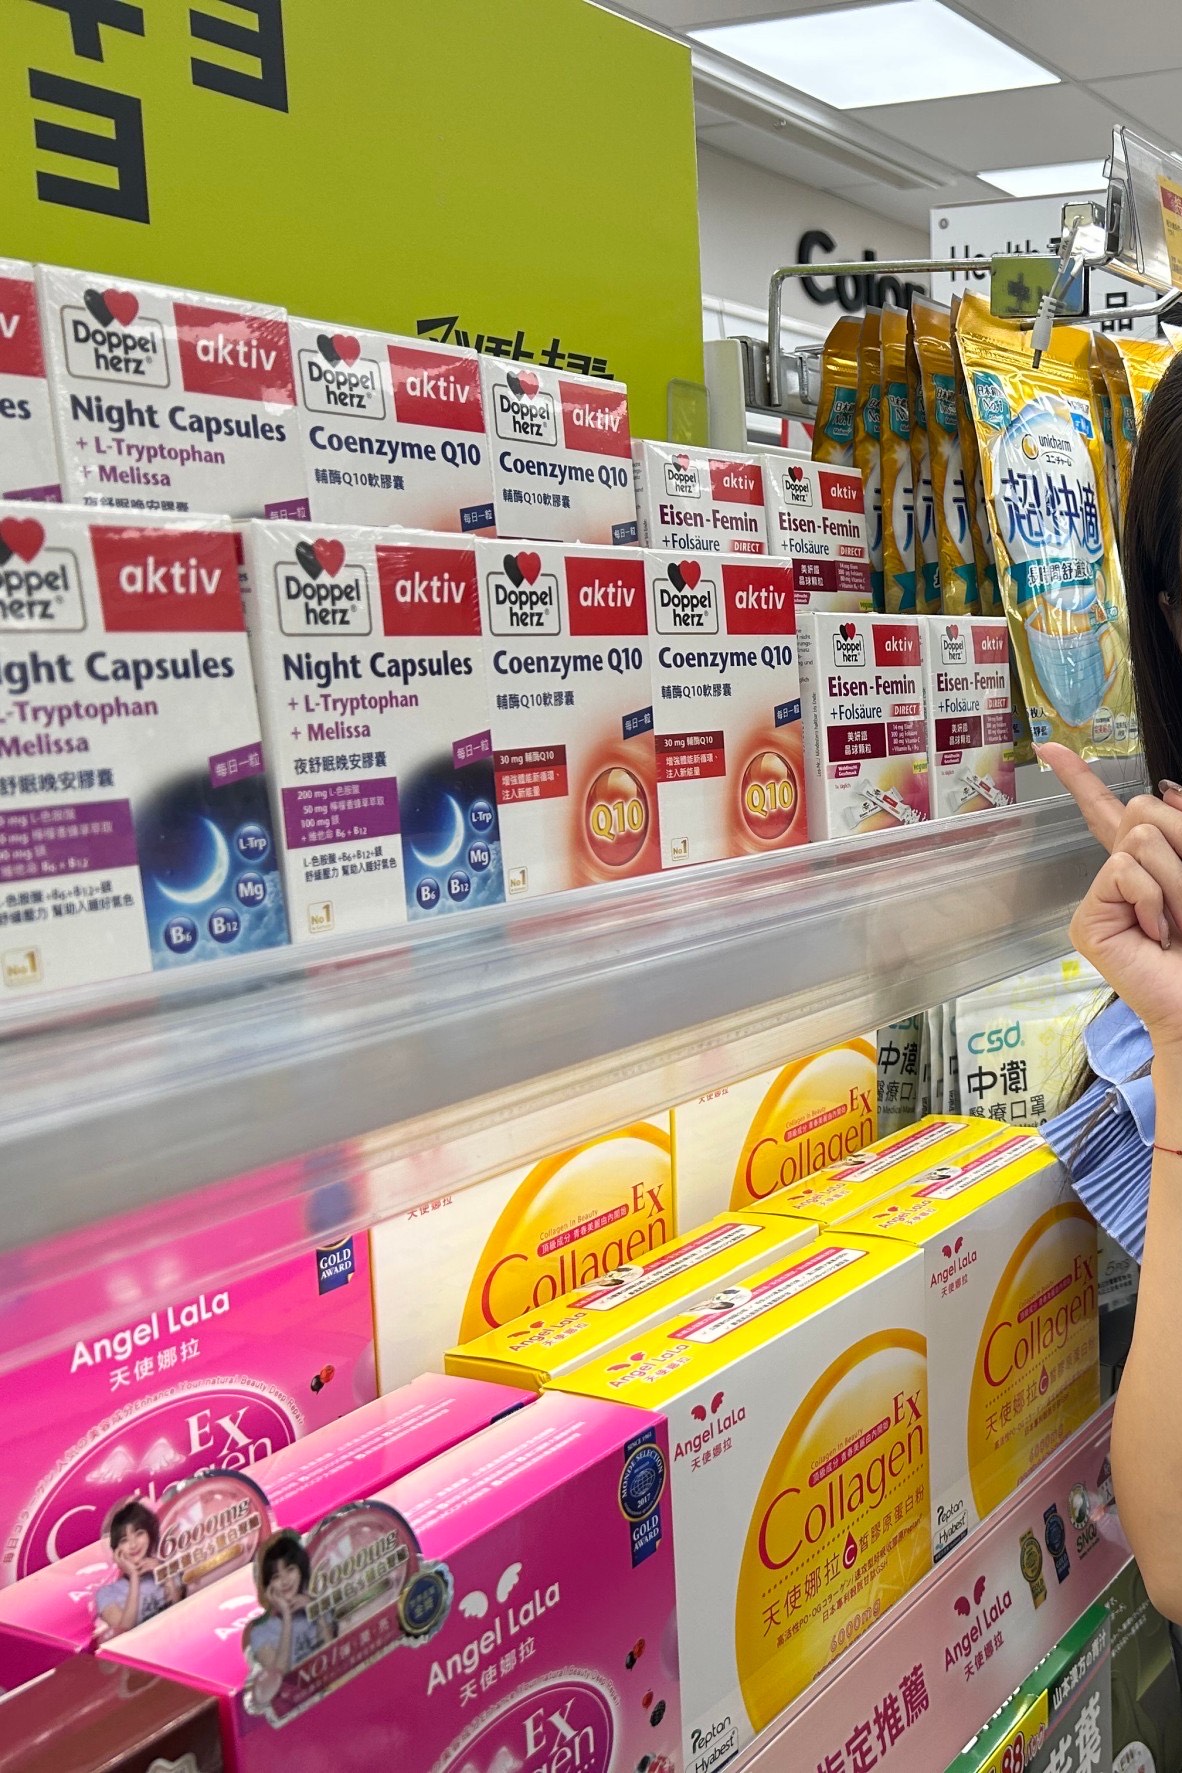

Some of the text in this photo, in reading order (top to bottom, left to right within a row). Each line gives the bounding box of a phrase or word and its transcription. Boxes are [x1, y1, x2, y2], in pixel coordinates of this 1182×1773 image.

[72, 318, 158, 354] Doppel
[94, 347, 147, 376] herz
[196, 333, 277, 371] aktiv
[309, 360, 375, 391] Doppel
[405, 375, 471, 404] aktiv
[325, 386, 367, 409] herz
[69, 393, 160, 433] Night
[168, 406, 287, 442] Capsules
[572, 407, 621, 433] aktiv
[94, 436, 226, 466] L-Tryptophan
[309, 425, 482, 468] Coenzyme Q10
[1038, 433, 1072, 452] unicharm
[98, 464, 172, 487] Melissa
[499, 450, 628, 489] Coenzyme Q10
[722, 474, 755, 491] aktiv
[830, 485, 857, 500] aktiv
[734, 542, 760, 553] DIRECT
[840, 546, 862, 557] DIRECT
[119, 556, 222, 595] aktiv
[395, 571, 466, 604] aktiv
[285, 575, 362, 606] Doppel
[494, 584, 553, 609] Doppel
[579, 579, 636, 608] aktiv
[660, 588, 712, 612] Doppel
[735, 582, 786, 610] aktiv
[304, 602, 351, 626] herz
[509, 606, 545, 627] herz
[673, 608, 704, 628] herz
[836, 639, 862, 657] Doppel
[885, 636, 913, 652] aktiv
[981, 636, 1004, 651] aktiv
[85, 649, 235, 690] Capsules
[282, 650, 473, 688] Night Capsules
[493, 647, 643, 680] Coenzyme Q10
[658, 646, 757, 675] Coenzyme
[760, 645, 793, 670] Q10
[304, 691, 419, 717] L-Tryptophan
[894, 704, 917, 716] DIRECT
[988, 698, 1007, 709] DIRECT
[307, 721, 371, 742] Melissa
[746, 780, 793, 817] Q10
[591, 798, 644, 841] Q10
[238, 836, 267, 850] L-Trp
[470, 849, 490, 865] Mg
[238, 882, 264, 900] Mg
[745, 1117, 874, 1200] Collagen
[540, 1209, 599, 1241] Collagen Beauty
[319, 1247, 352, 1270] GOLD
[320, 1260, 353, 1280] AWARD
[930, 1250, 978, 1289] Angel LaLa
[481, 1217, 667, 1330] Collagen
[70, 1291, 231, 1374] Angel LaLa
[983, 1283, 1095, 1387] Collagen
[109, 1338, 202, 1392] 天使娜拉
[608, 1358, 656, 1390] Angel
[673, 1406, 746, 1462] Angel LaLa
[690, 1437, 733, 1472] 天使娜拉
[758, 1423, 925, 1570] Collagen
[632, 1514, 659, 1541] GOLD
[633, 1527, 660, 1552] AWARD
[426, 1618, 501, 1696] Angel
[508, 1582, 561, 1636] LaLa
[944, 1589, 1013, 1673] Angel LaLa
[459, 1636, 537, 1708] 天使娜拉
